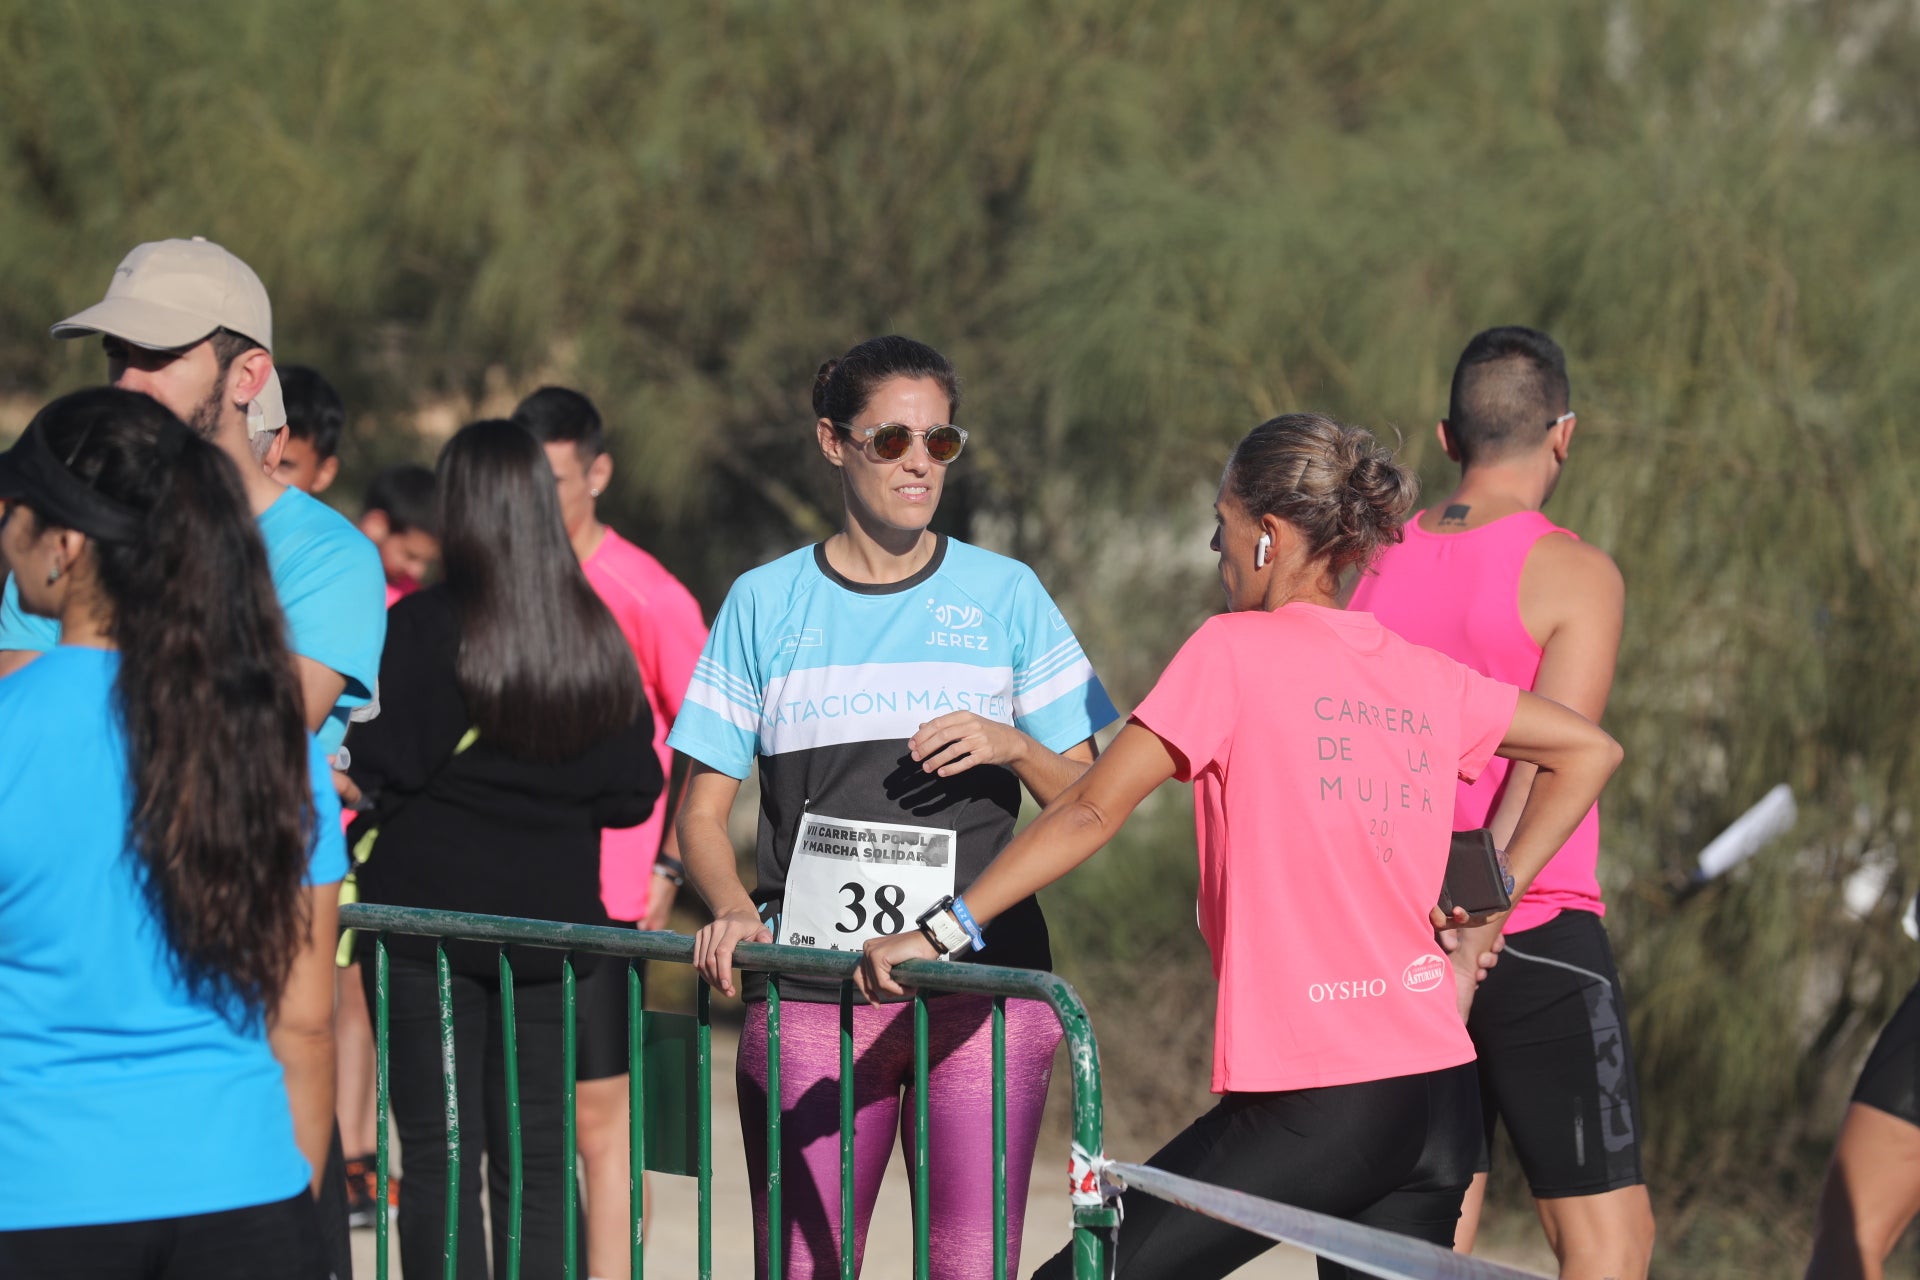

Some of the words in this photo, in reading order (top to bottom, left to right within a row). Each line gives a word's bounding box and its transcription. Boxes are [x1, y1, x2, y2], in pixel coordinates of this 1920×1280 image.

[926, 632, 988, 650] JEREZ
[1314, 696, 1433, 736] CARRERA
[1317, 736, 1352, 761] DE
[1408, 748, 1431, 775] LA
[1320, 776, 1433, 813] MUJER
[807, 825, 818, 836] VII
[818, 827, 877, 843] CARRERA
[802, 840, 809, 850] Y
[808, 841, 859, 858] MARCHA
[835, 882, 906, 935] 38
[801, 934, 816, 945] NB
[1309, 978, 1387, 1003] OYSHO
